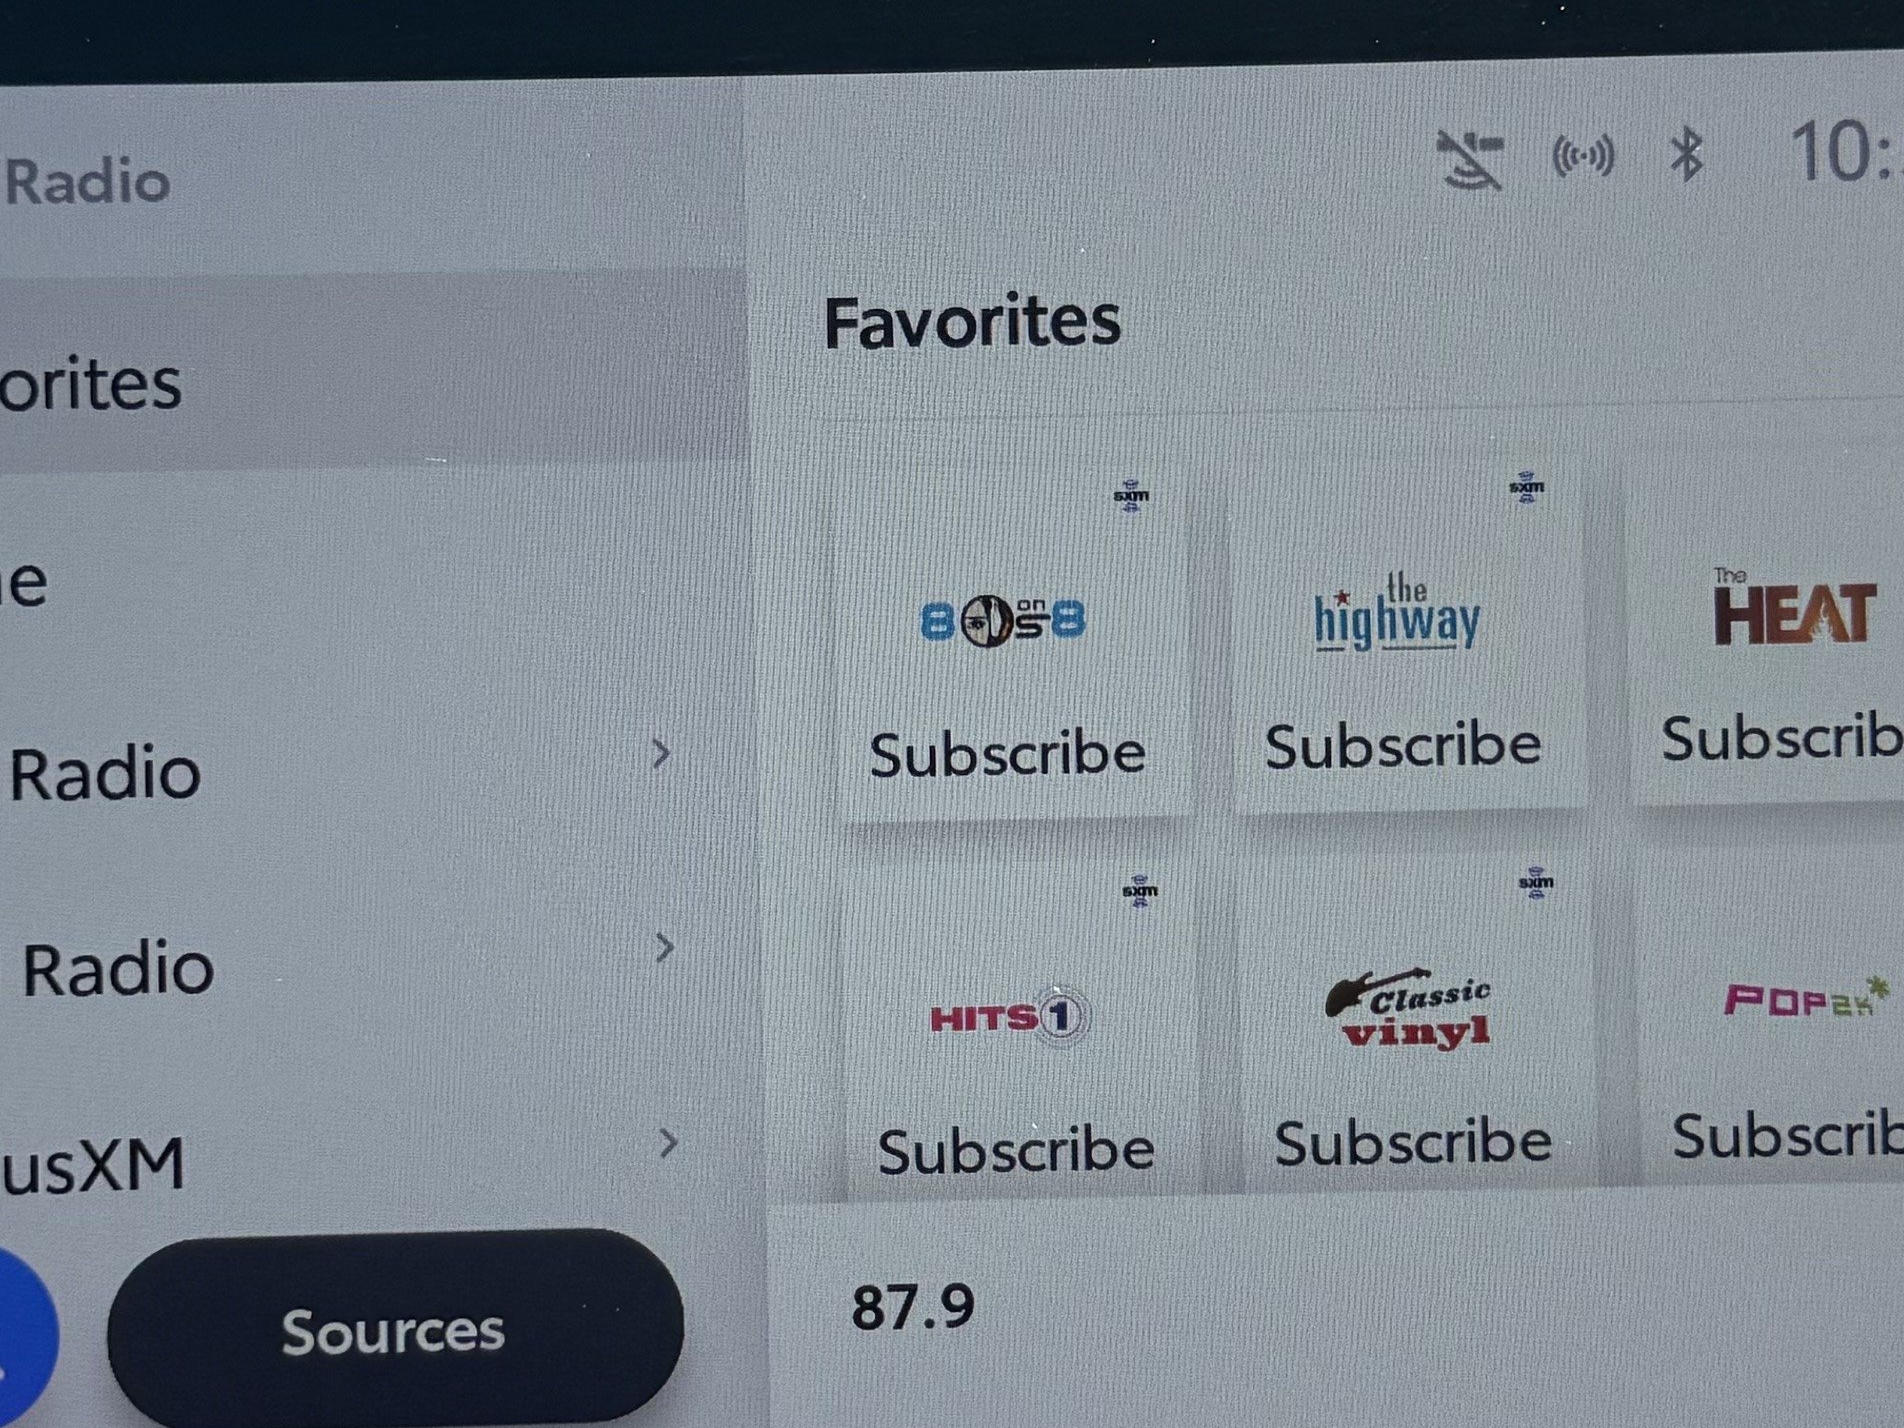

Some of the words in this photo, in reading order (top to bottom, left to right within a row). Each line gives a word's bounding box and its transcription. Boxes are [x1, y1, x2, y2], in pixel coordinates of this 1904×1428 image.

[5, 155, 171, 205] Radio
[826, 290, 1122, 350] Favorites
[1387, 570, 1428, 604] the
[1713, 566, 1748, 584] The
[1314, 590, 1482, 653] highway
[1713, 583, 1878, 646] HEAT
[870, 726, 1146, 778] Subscribe
[1266, 717, 1542, 770] Subscribe
[12, 742, 201, 802] Radio
[25, 937, 214, 998] Radio
[1369, 977, 1492, 1015] Classic
[1341, 1014, 1491, 1053] vinyl
[879, 1122, 1155, 1176] Subscribe
[1276, 1114, 1552, 1167] Subscribe
[282, 1308, 506, 1357] Sources
[852, 1282, 975, 1331] 87.9
